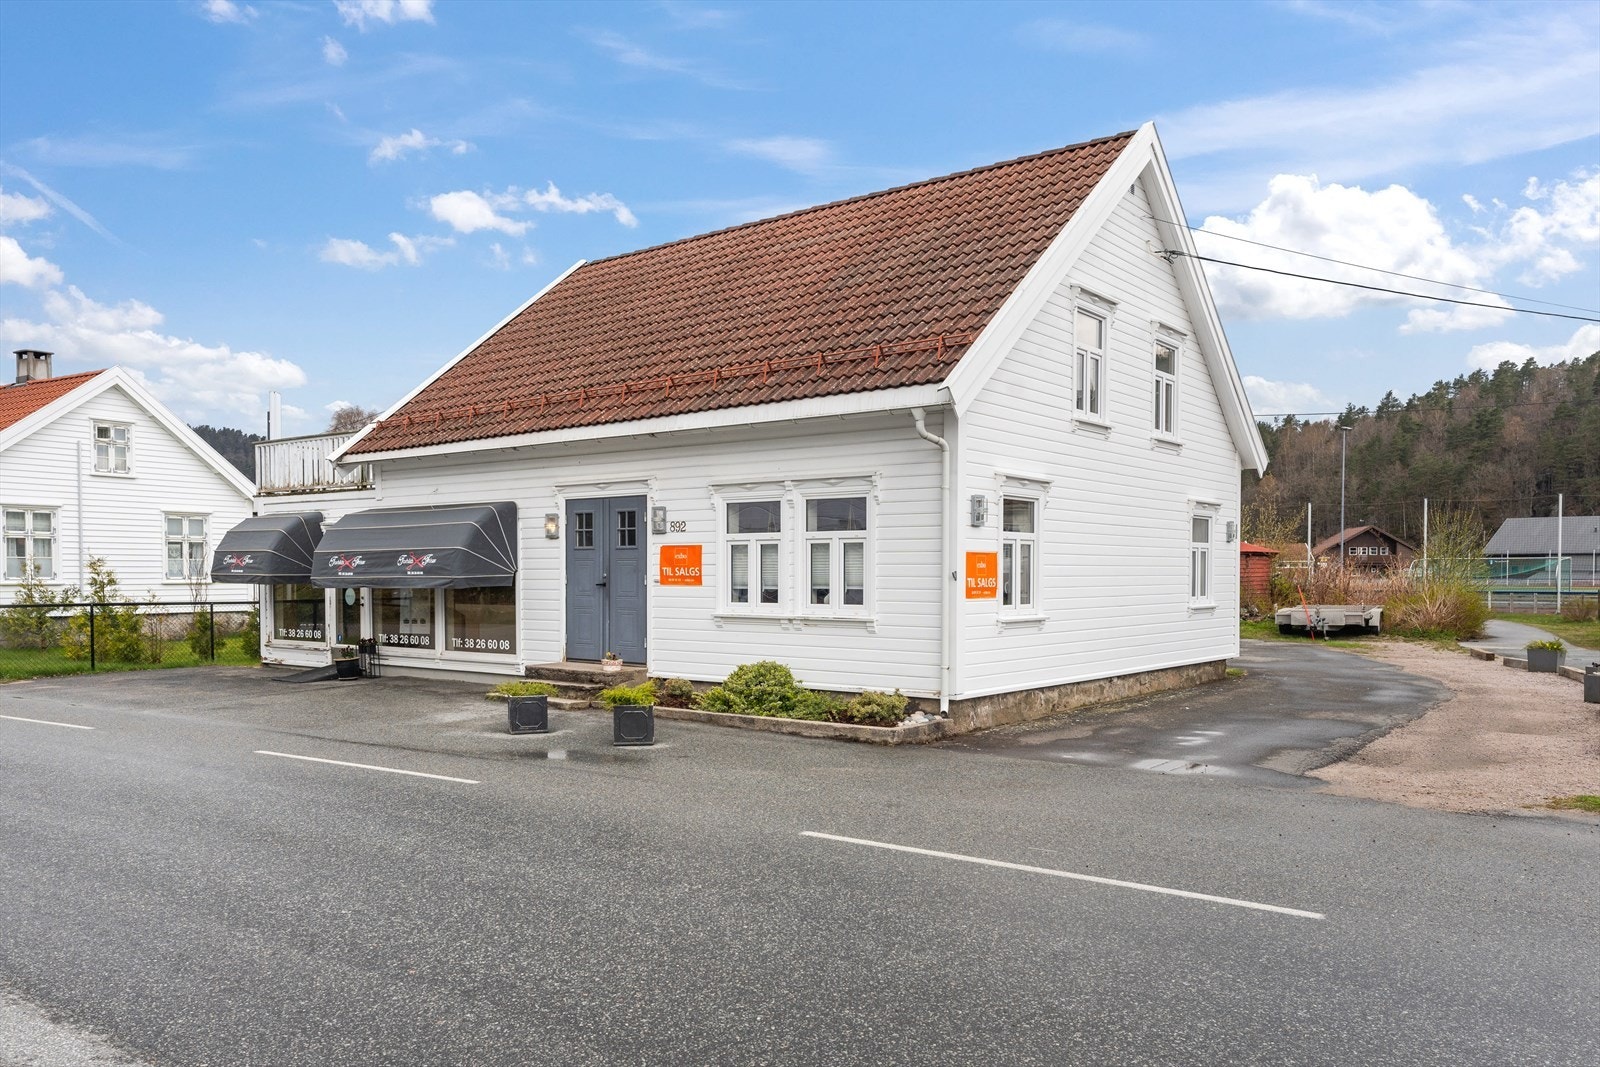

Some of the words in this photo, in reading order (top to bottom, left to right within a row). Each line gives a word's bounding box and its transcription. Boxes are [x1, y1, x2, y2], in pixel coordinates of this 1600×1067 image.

[670, 520, 687, 533] 892
[661, 567, 674, 576] TIL
[675, 567, 700, 576] SALGS
[967, 577, 976, 588] TIL
[977, 577, 996, 588] SALGS
[279, 629, 287, 637] Tlf:
[288, 629, 296, 638] 38
[296, 629, 304, 638] 26
[305, 629, 312, 638] 60
[313, 630, 322, 639] 08
[378, 633, 388, 643] Tlf:
[389, 634, 398, 644] 38
[400, 634, 409, 645] 26
[409, 635, 419, 645] 60
[420, 636, 430, 646] 08
[451, 638, 463, 648] Tlf:
[464, 638, 474, 649] 38
[475, 639, 486, 649] 26
[487, 639, 498, 650] 60
[499, 640, 510, 650] 08
